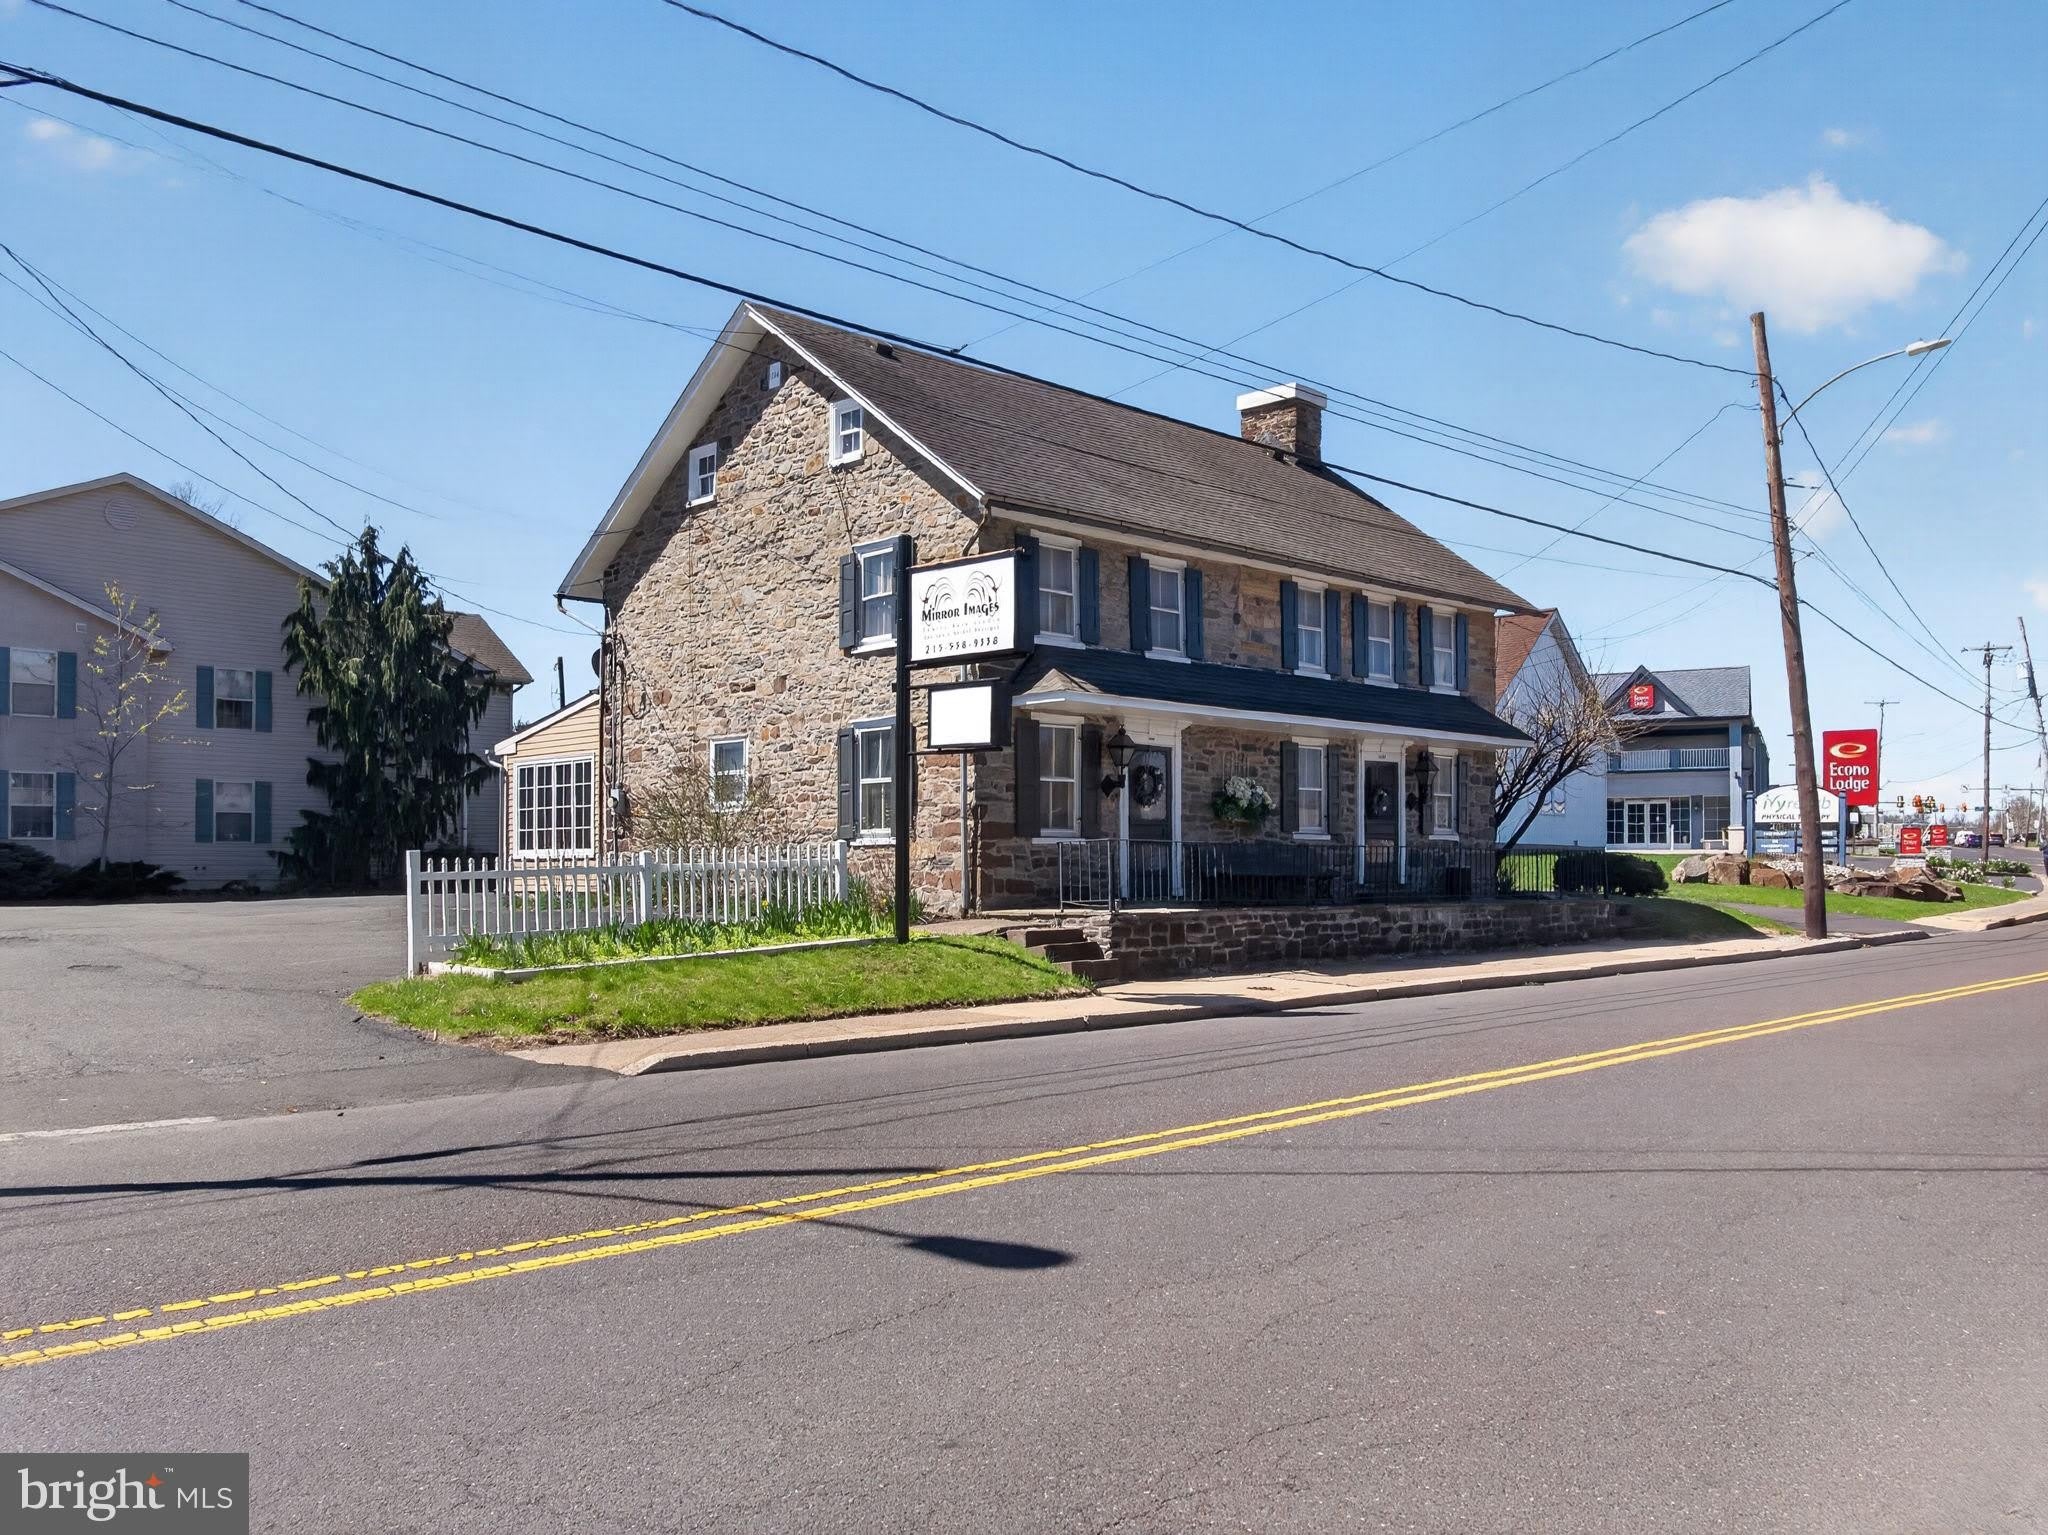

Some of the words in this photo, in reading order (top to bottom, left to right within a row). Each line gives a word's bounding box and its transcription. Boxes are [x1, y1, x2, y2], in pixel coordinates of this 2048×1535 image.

[964, 602, 999, 616] IMAGES
[1829, 761, 1870, 776] Econo
[1829, 776, 1870, 792] Lodge
